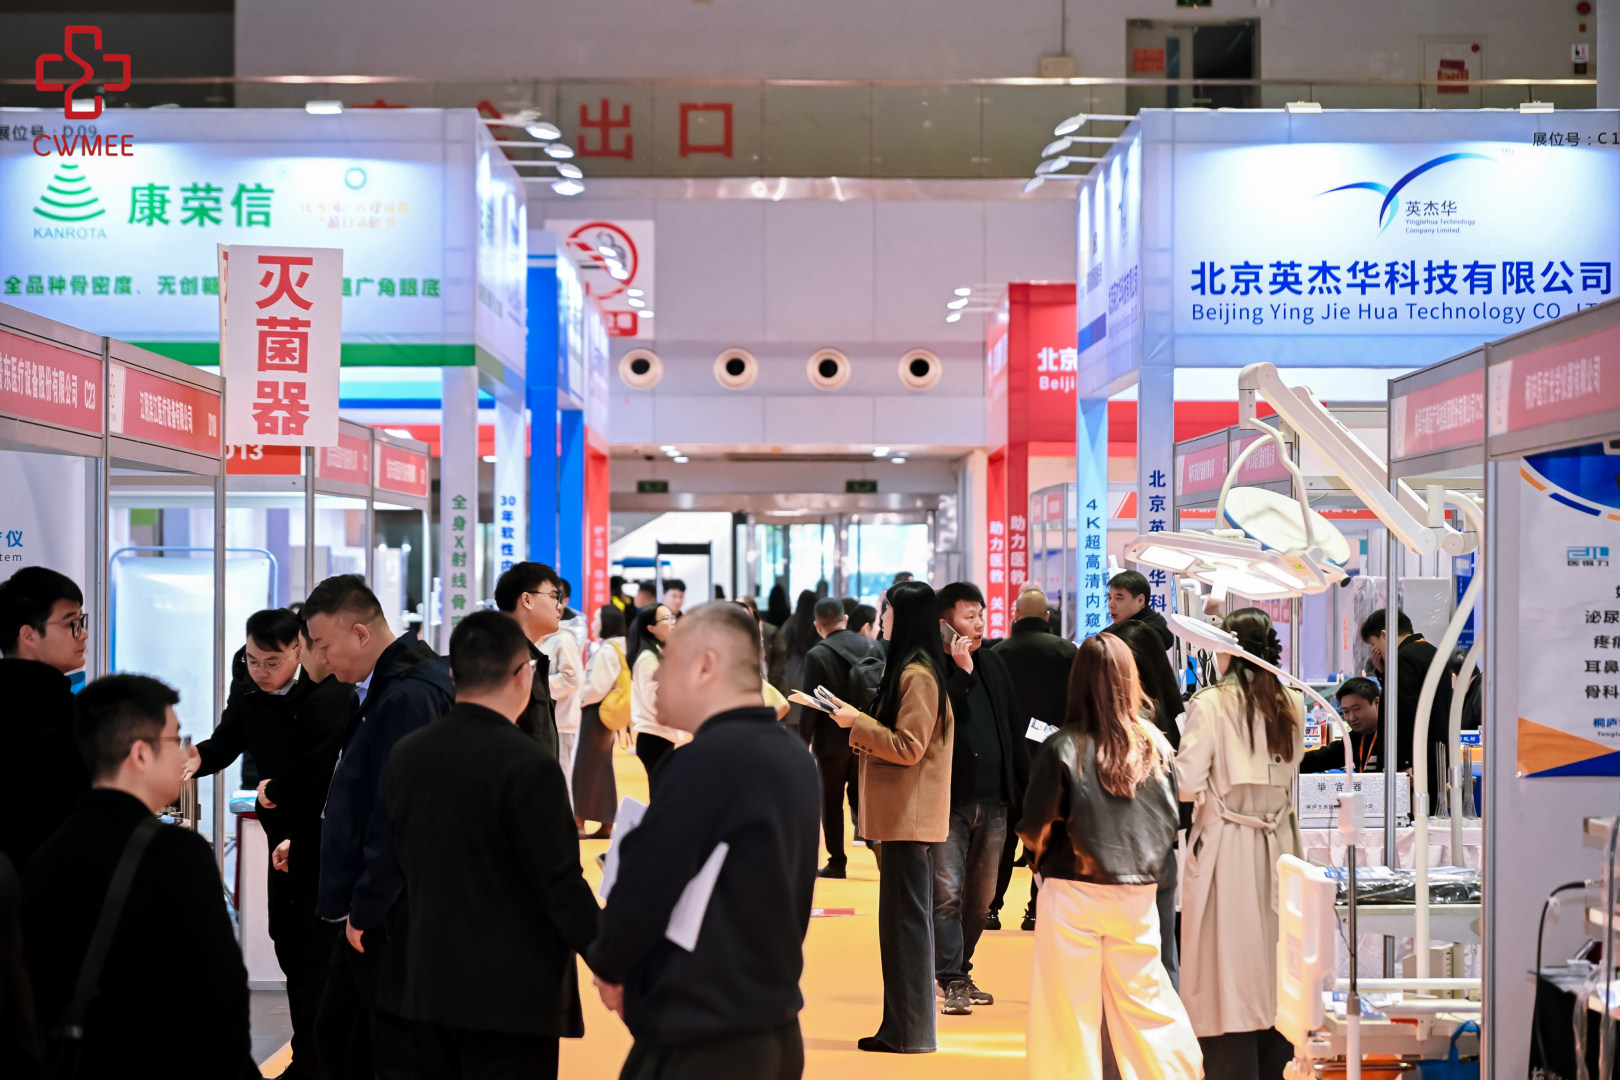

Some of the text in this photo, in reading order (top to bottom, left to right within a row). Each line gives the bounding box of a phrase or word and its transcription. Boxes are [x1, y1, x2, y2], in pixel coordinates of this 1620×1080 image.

[128, 182, 274, 228] 康荣信
[1405, 200, 1458, 217] 英杰华
[1405, 227, 1435, 235] Company
[1440, 218, 1476, 226] Technology
[34, 227, 107, 240] KANROTA
[1191, 260, 1611, 296] 北京英杰华科技有限公司
[1192, 303, 1264, 325] Beijing
[1270, 303, 1314, 325] Ying
[1321, 303, 1351, 320] Jie
[1358, 303, 1398, 320] Hua
[1405, 302, 1526, 325] Technology
[252, 255, 314, 436] 灭菌器
[84, 379, 96, 410] C23
[989, 521, 1004, 584] 助力医教
[1010, 515, 1026, 585] 助力医教
[1585, 660, 1619, 674] 耳鼻
[1585, 685, 1619, 699] 骨科
[1593, 718, 1620, 728] 桐庐
